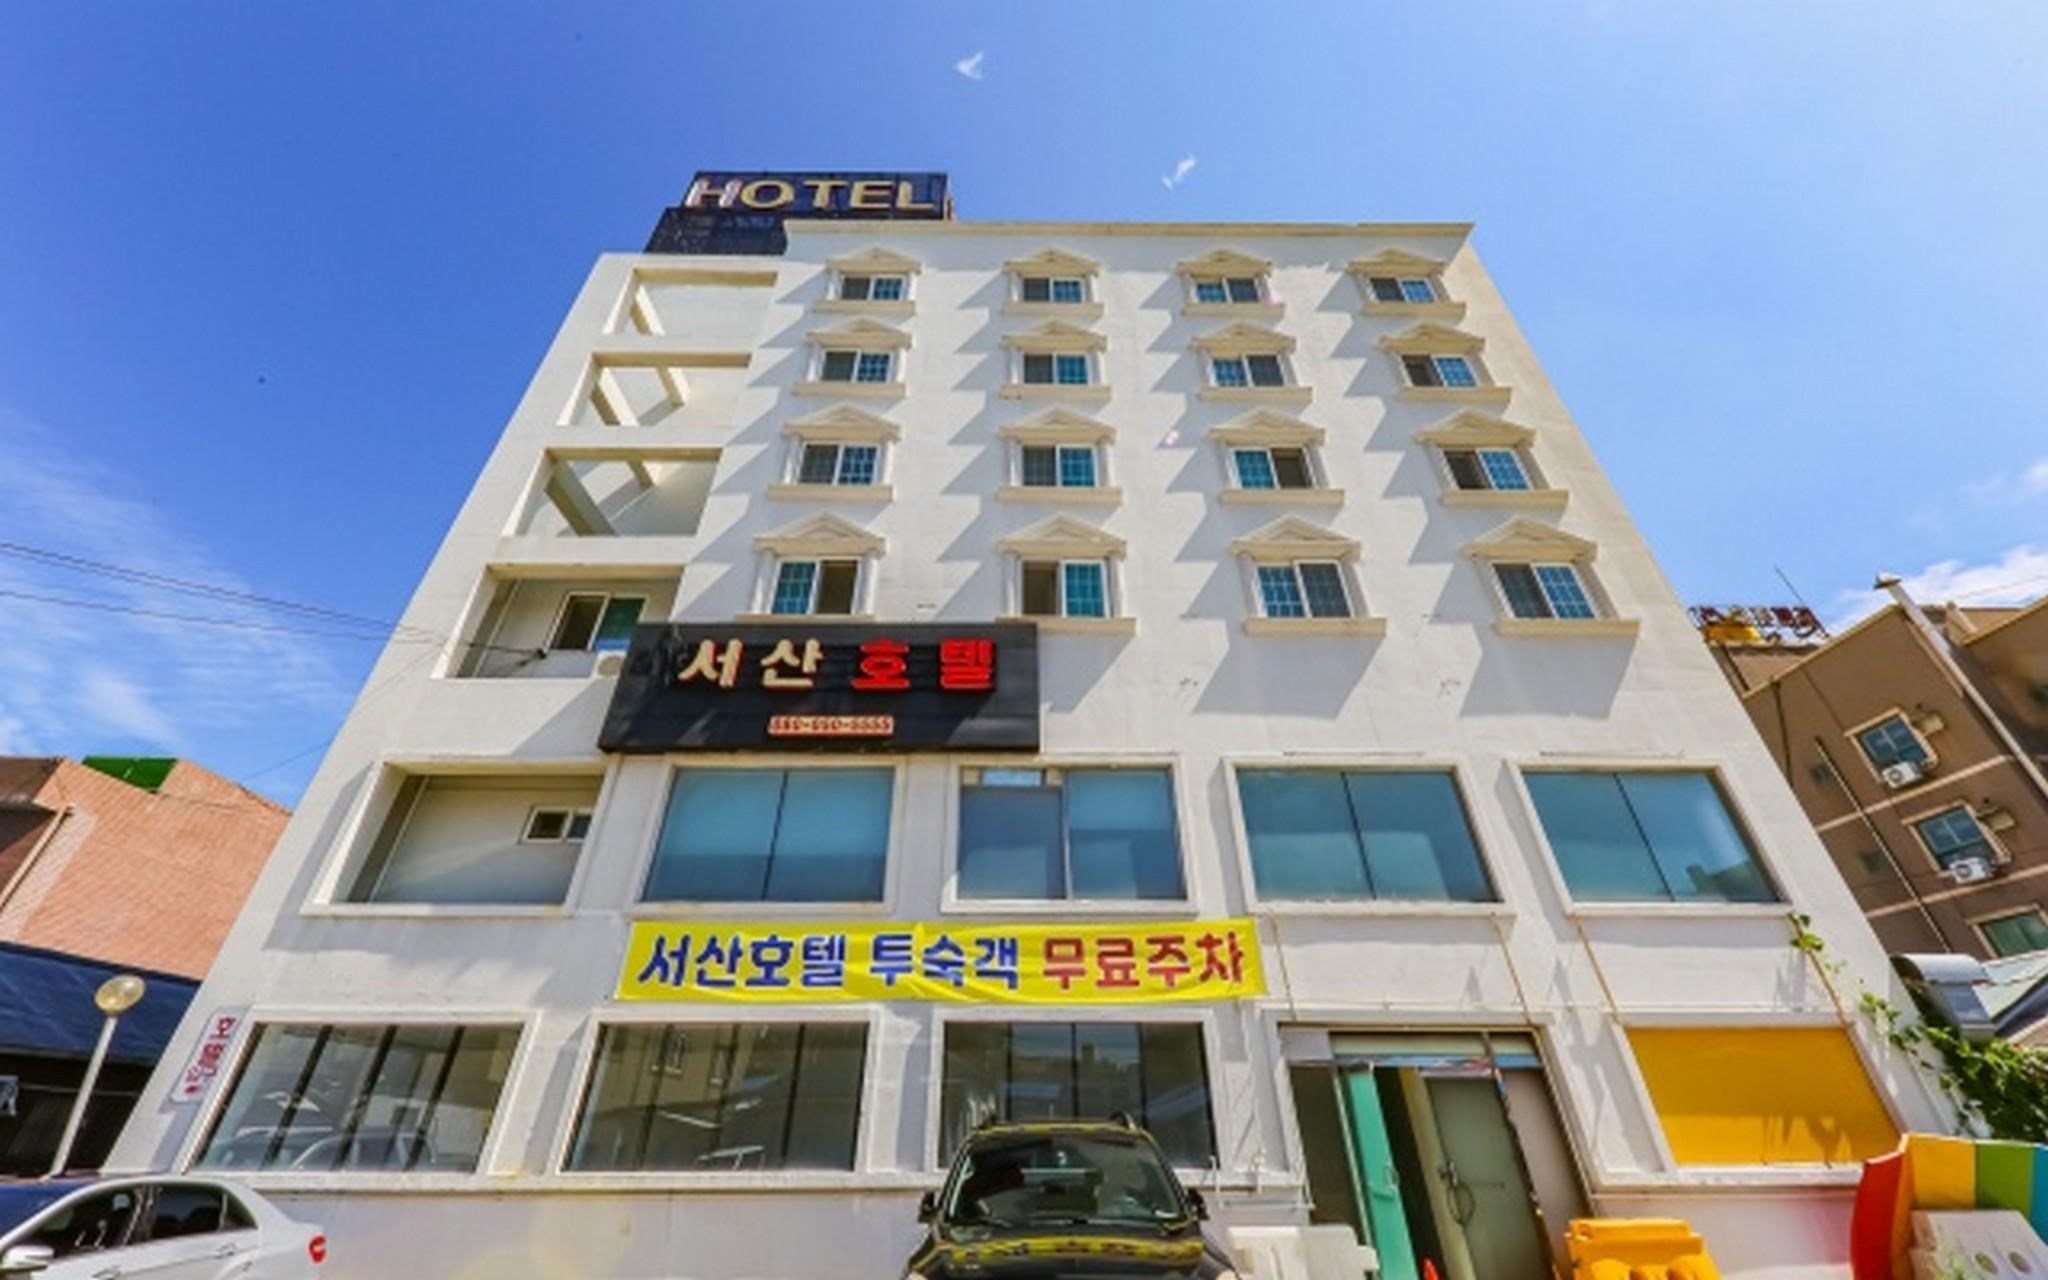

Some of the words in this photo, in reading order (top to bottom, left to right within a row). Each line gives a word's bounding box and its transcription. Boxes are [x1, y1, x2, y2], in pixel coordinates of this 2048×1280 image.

[685, 179, 936, 209] HOTEL
[678, 638, 824, 688] 서산
[851, 638, 996, 689] 호텔
[638, 934, 846, 987] 서산호텔
[868, 934, 1019, 990] 투숙객
[1043, 931, 1244, 990] 무료주차
